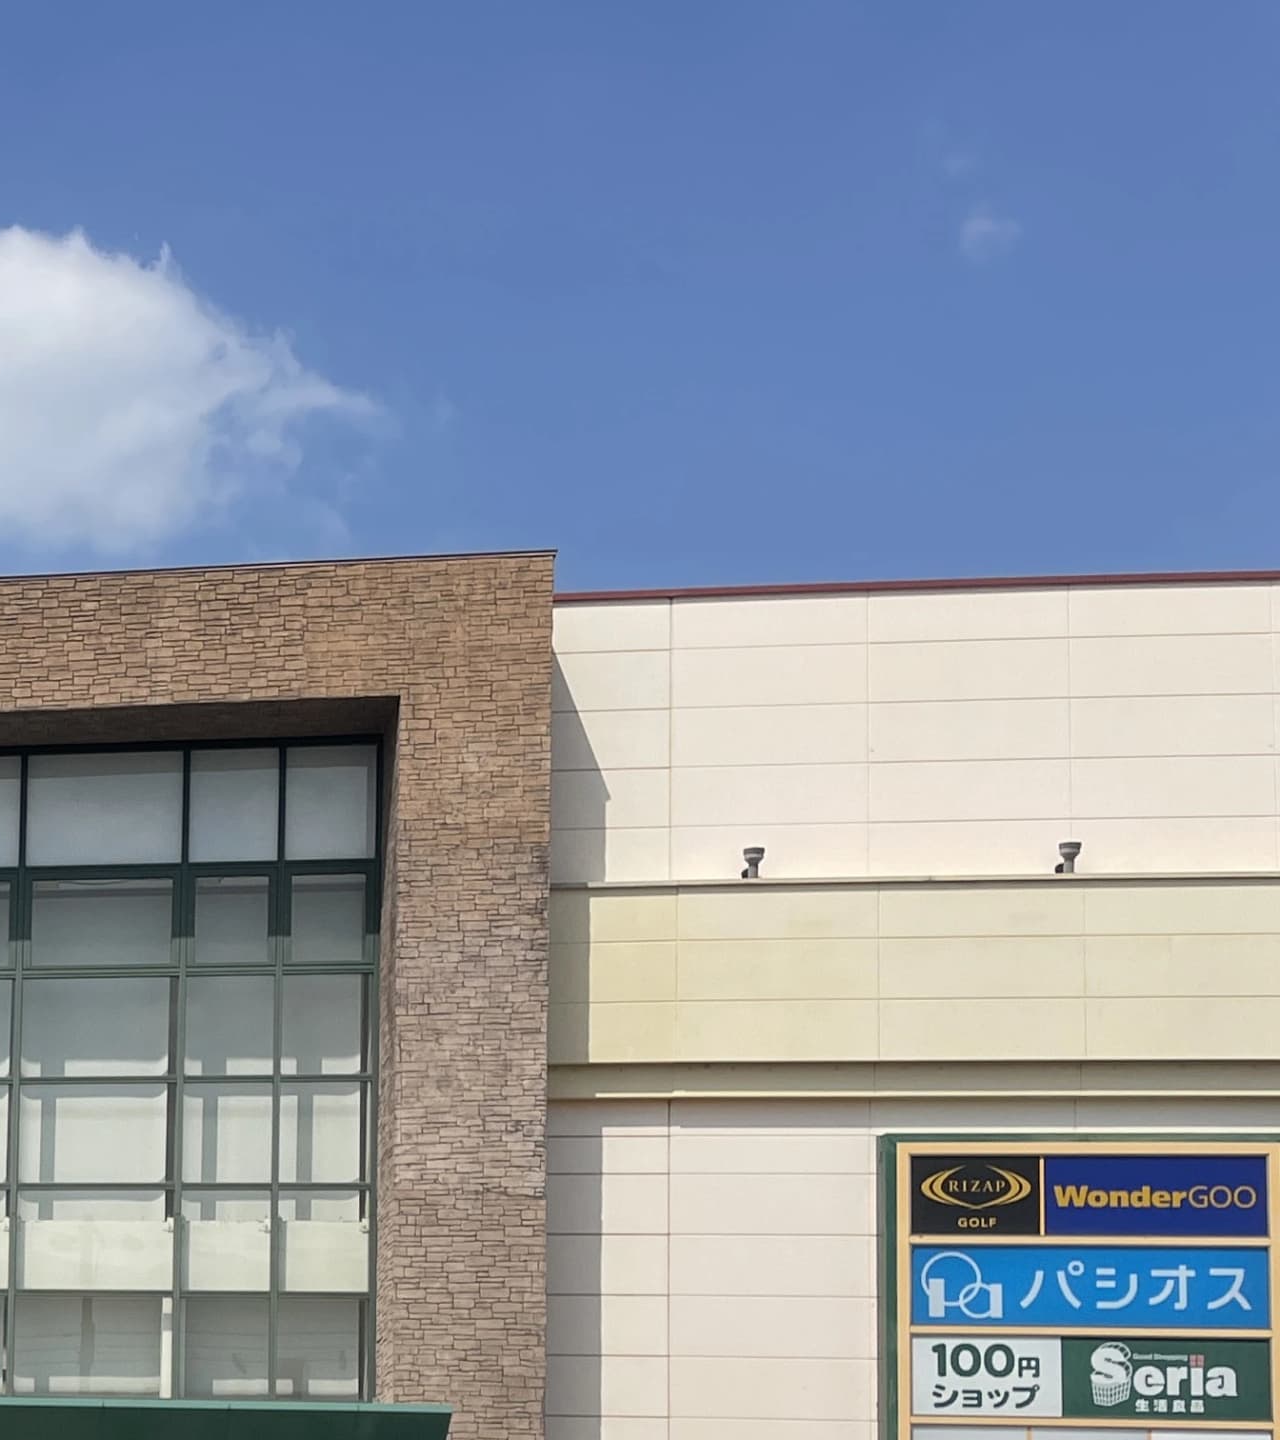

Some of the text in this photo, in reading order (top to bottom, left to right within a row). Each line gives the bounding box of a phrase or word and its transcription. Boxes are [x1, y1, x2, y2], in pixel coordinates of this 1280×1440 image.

[948, 1179, 1006, 1194] RIZAP
[1053, 1184, 1257, 1209] WonderGOO
[957, 1217, 997, 1228] GOLF
[1020, 1260, 1252, 1311] パシオス
[931, 1343, 1041, 1379] 100円
[1090, 1342, 1238, 1407] Seria
[931, 1384, 1041, 1409] ショップ
